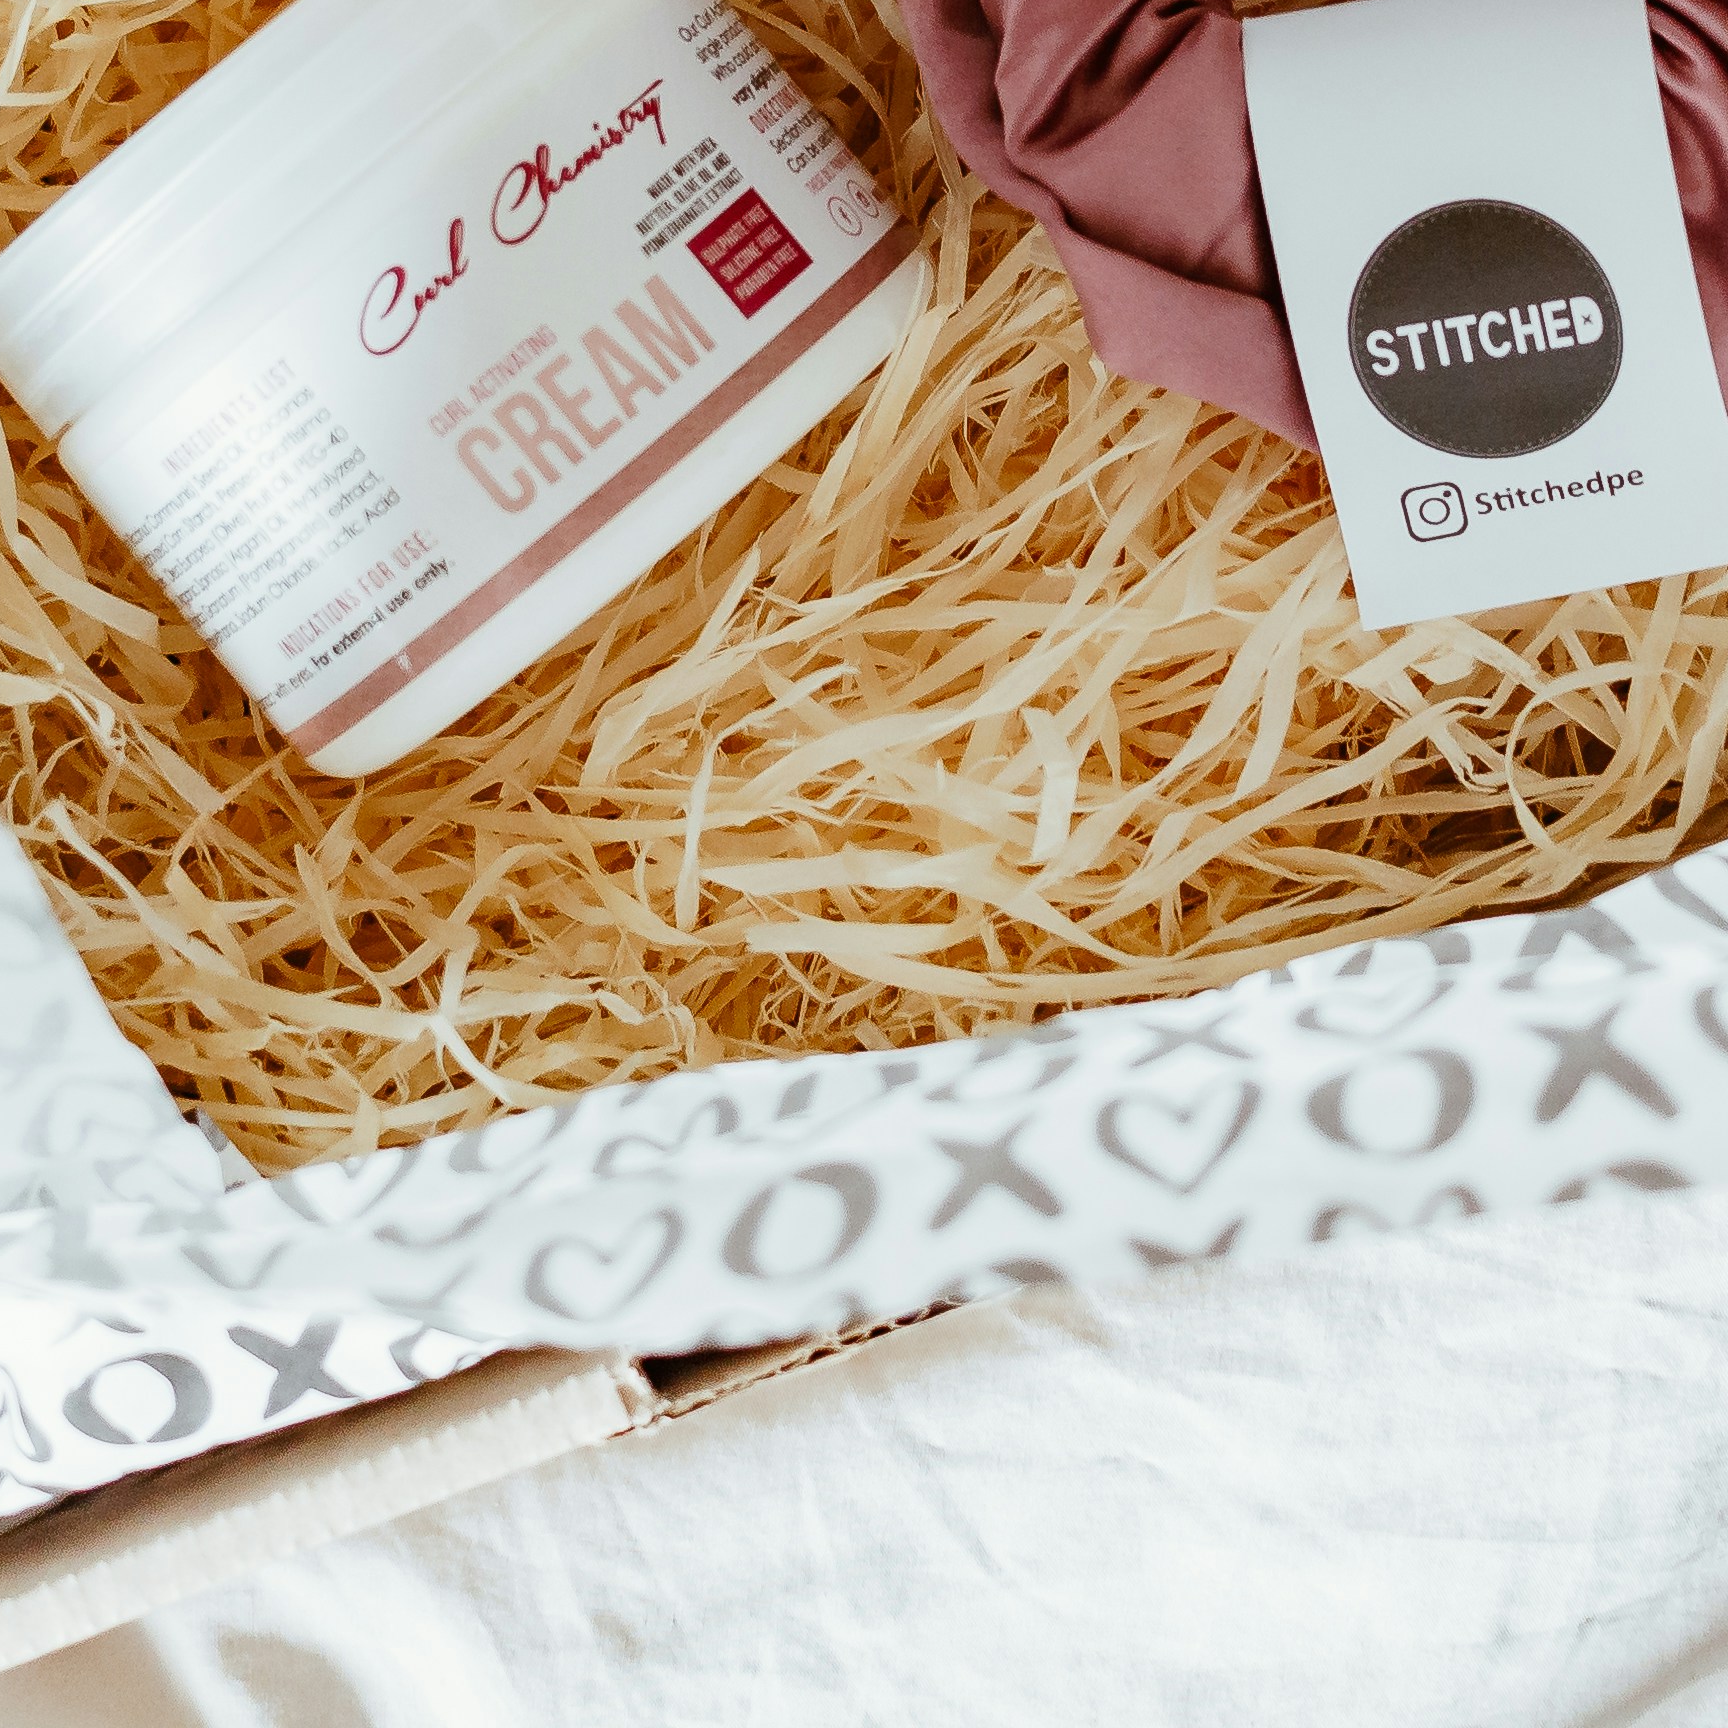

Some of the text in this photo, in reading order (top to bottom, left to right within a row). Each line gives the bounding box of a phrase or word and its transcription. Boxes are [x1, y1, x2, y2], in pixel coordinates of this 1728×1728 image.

[361, 78, 667, 356] Curl Chemistry
[251, 356, 298, 402] LIST
[1366, 294, 1605, 378] STITCHED
[457, 272, 717, 511] CREAM
[1475, 464, 1645, 516] Stitchedpe
[276, 584, 362, 661] INDICATIONS
[355, 557, 396, 599] FOR
